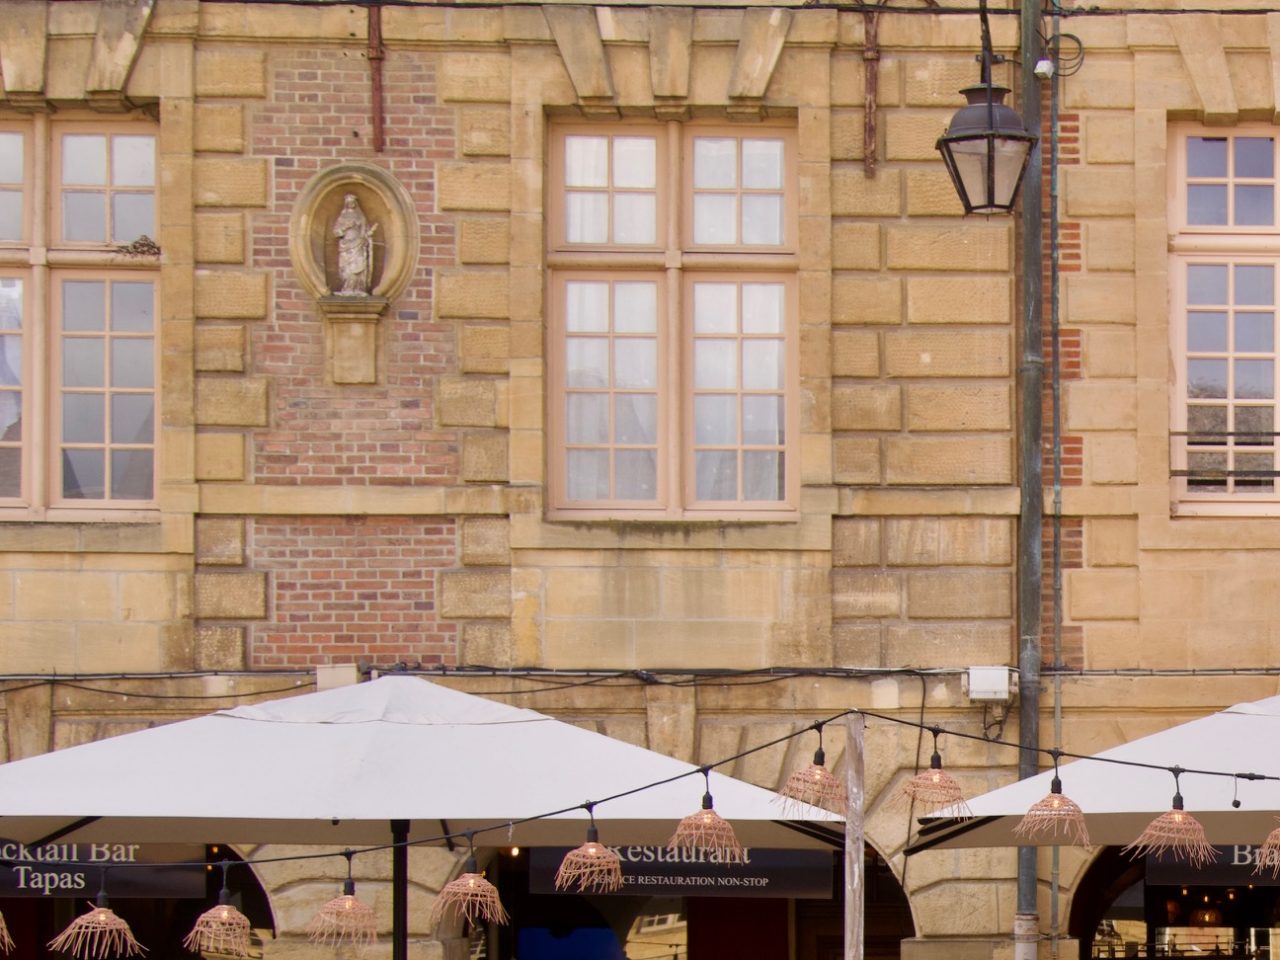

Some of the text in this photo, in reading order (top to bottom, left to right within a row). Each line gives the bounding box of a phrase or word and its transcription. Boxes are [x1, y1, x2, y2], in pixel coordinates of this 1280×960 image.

[0, 844, 140, 863] cktail Bar
[13, 865, 86, 896] Tapas
[593, 875, 769, 887] SERCE RESTAURATION NON-STOP
